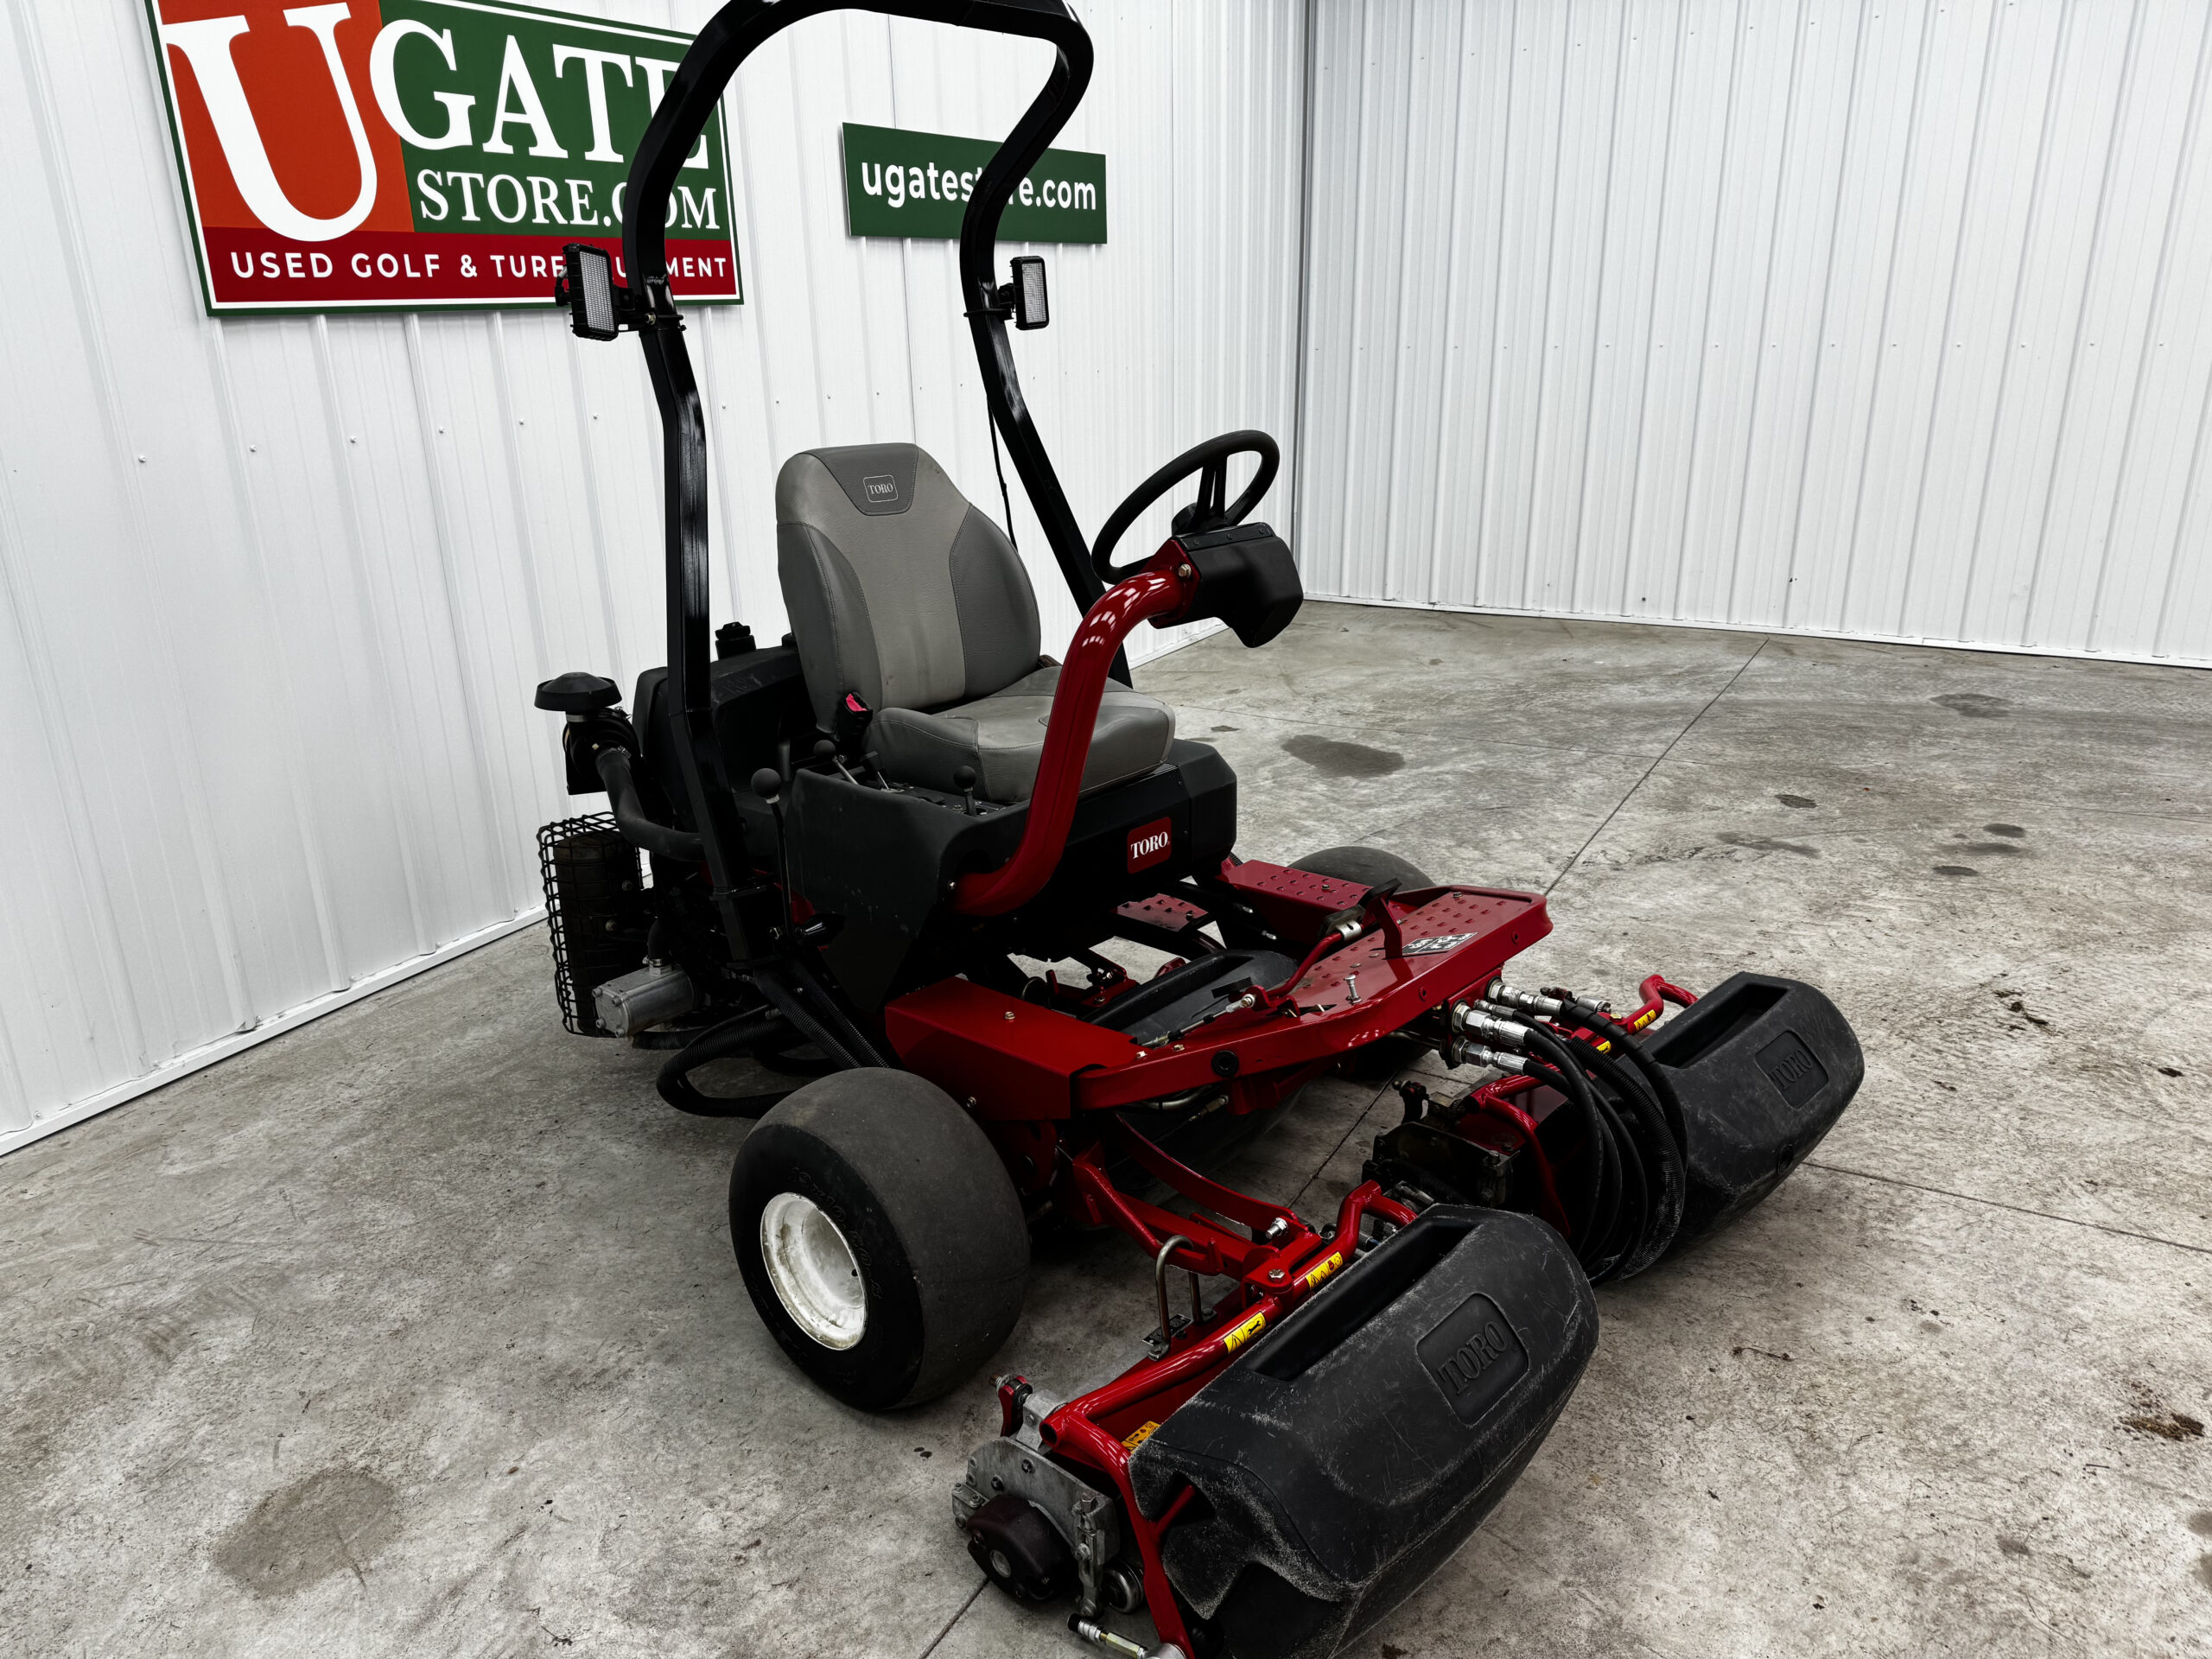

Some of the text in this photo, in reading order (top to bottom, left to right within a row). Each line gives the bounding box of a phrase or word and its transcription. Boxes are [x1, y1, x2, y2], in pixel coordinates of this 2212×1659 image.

[861, 161, 1096, 208] ugatese.com
[230, 251, 334, 279] USED
[351, 252, 441, 278] GOLF
[460, 254, 478, 277] &
[489, 254, 564, 277] TURF
[867, 483, 893, 495] TORO
[1130, 831, 1168, 859] TORO
[1769, 1049, 1813, 1090] TORO
[1437, 1320, 1508, 1395] TORO
